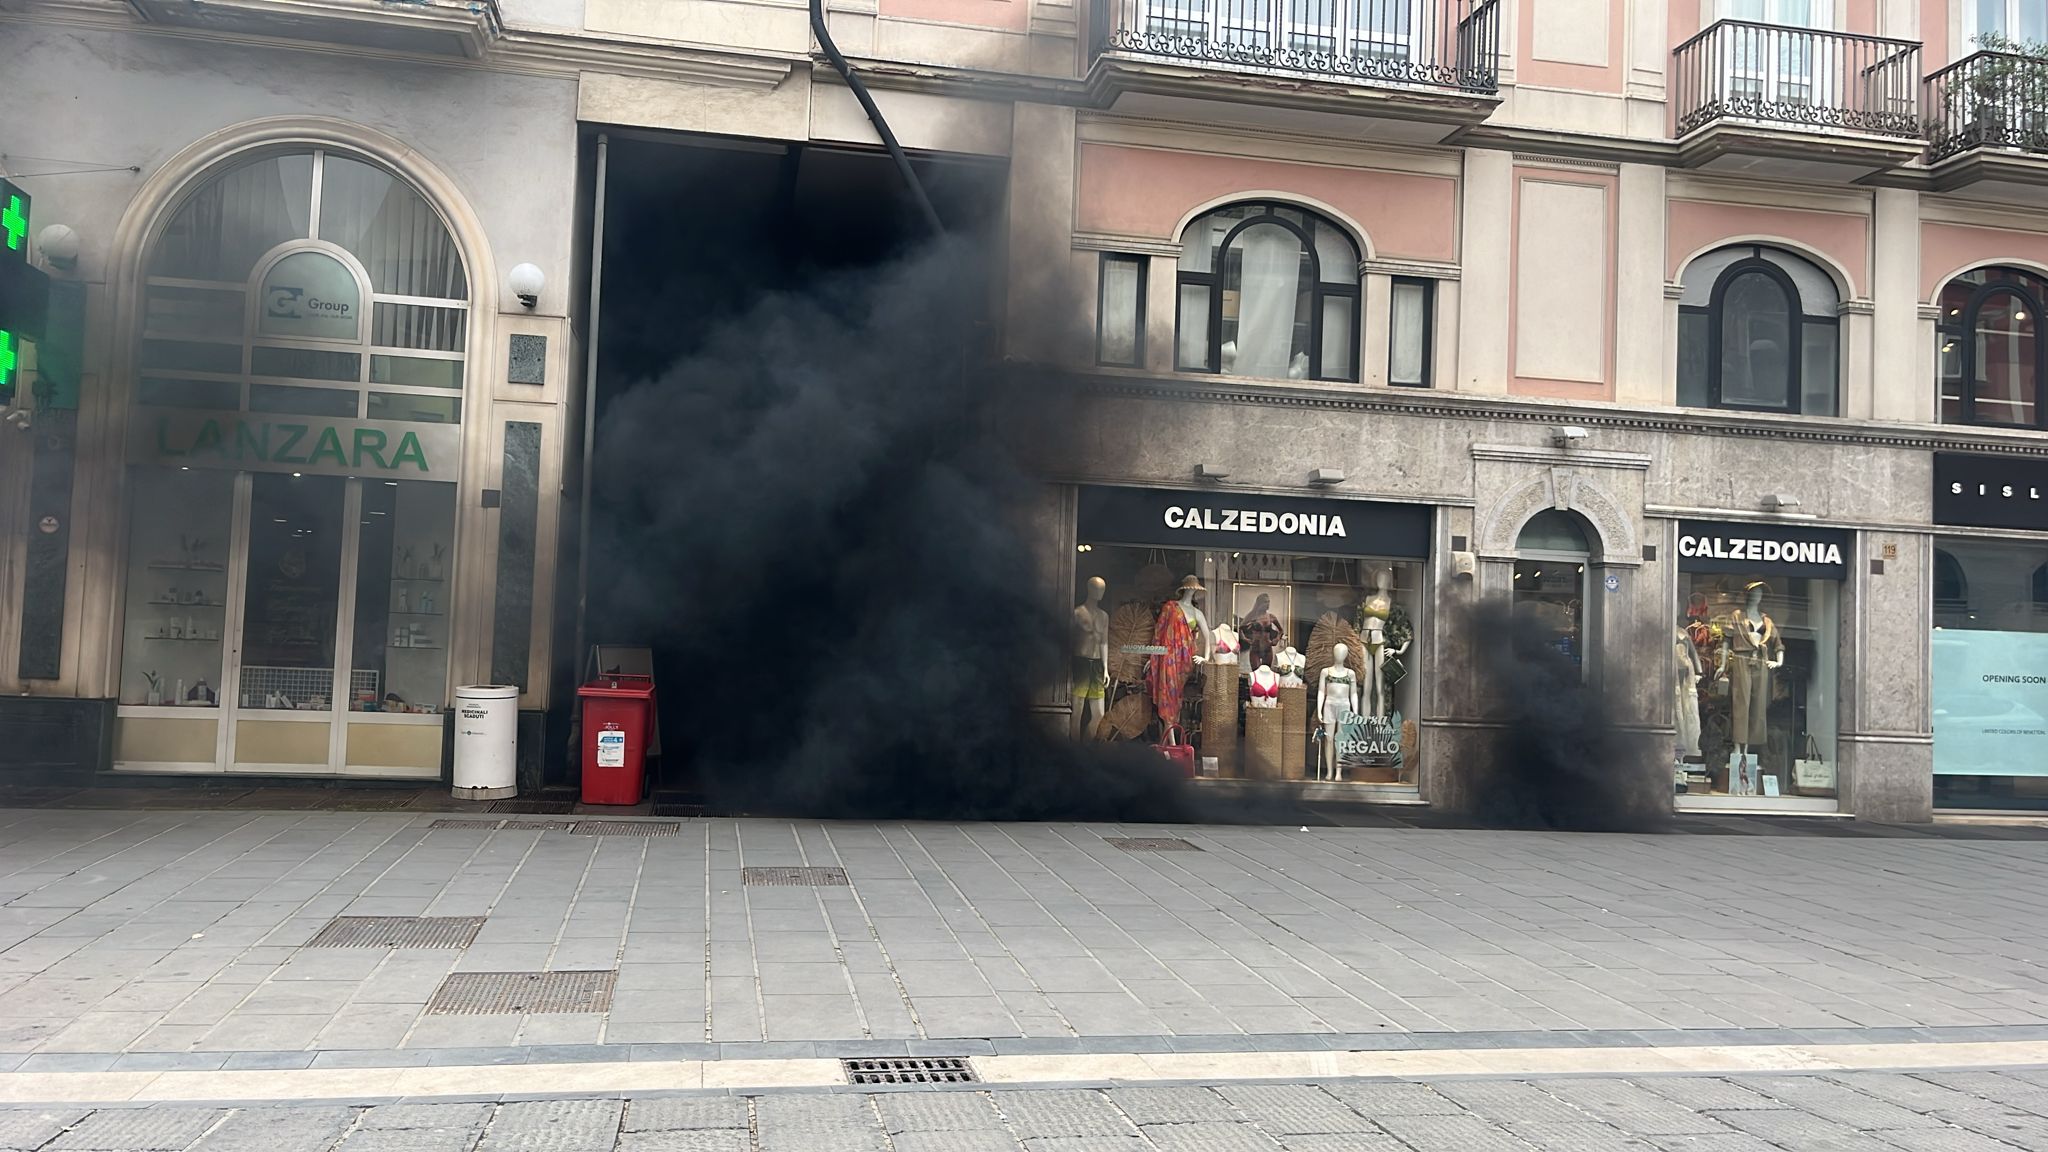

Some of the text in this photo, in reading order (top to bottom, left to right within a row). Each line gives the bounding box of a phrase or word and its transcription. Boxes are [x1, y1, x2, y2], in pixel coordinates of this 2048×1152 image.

[308, 298, 349, 314] Group
[157, 416, 429, 471] LANZARA
[1164, 506, 1346, 537] CALZEDONIA
[1678, 535, 1842, 565] CALZEDONIA
[1884, 545, 1896, 555] 119
[1982, 674, 2046, 684] OPENING SOON
[1340, 710, 1388, 725] Borsa
[1339, 740, 1399, 754] REGALO
